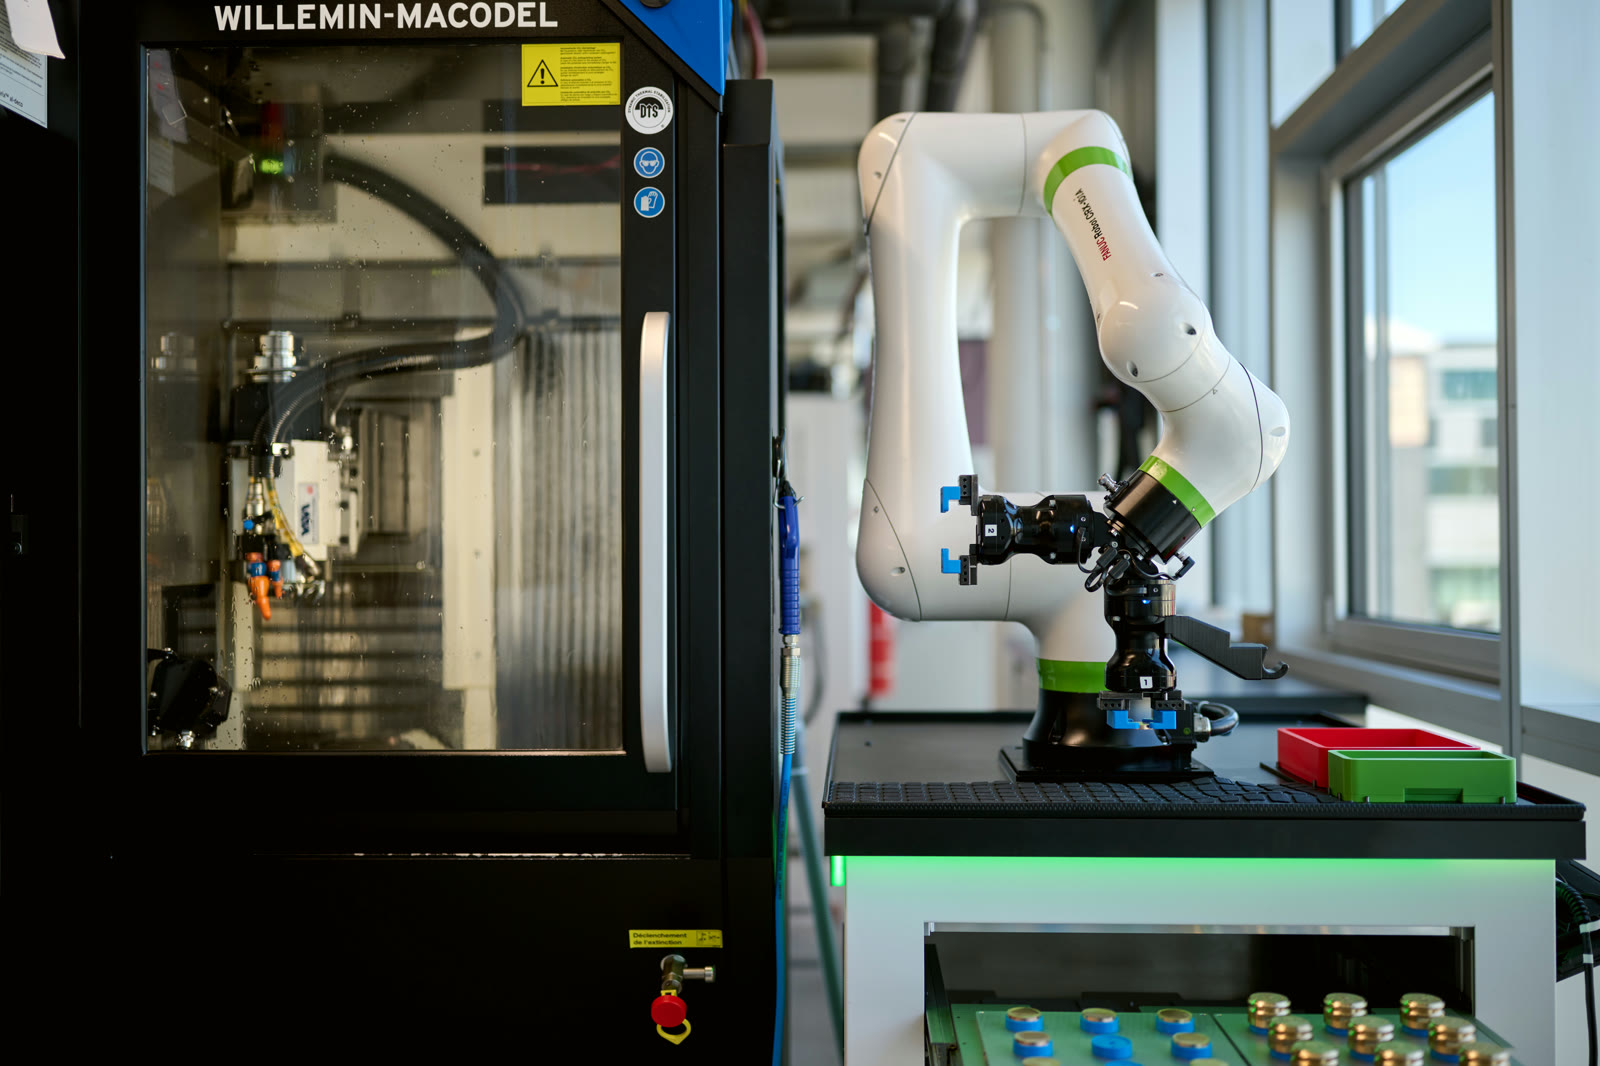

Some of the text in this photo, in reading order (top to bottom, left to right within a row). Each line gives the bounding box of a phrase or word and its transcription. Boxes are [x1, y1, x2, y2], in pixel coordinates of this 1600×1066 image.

[214, 2, 558, 31] WILLEMIN-MACODEL
[640, 103, 659, 118] DTS
[1089, 217, 1103, 240] Robot
[1096, 236, 1112, 261] FANUC
